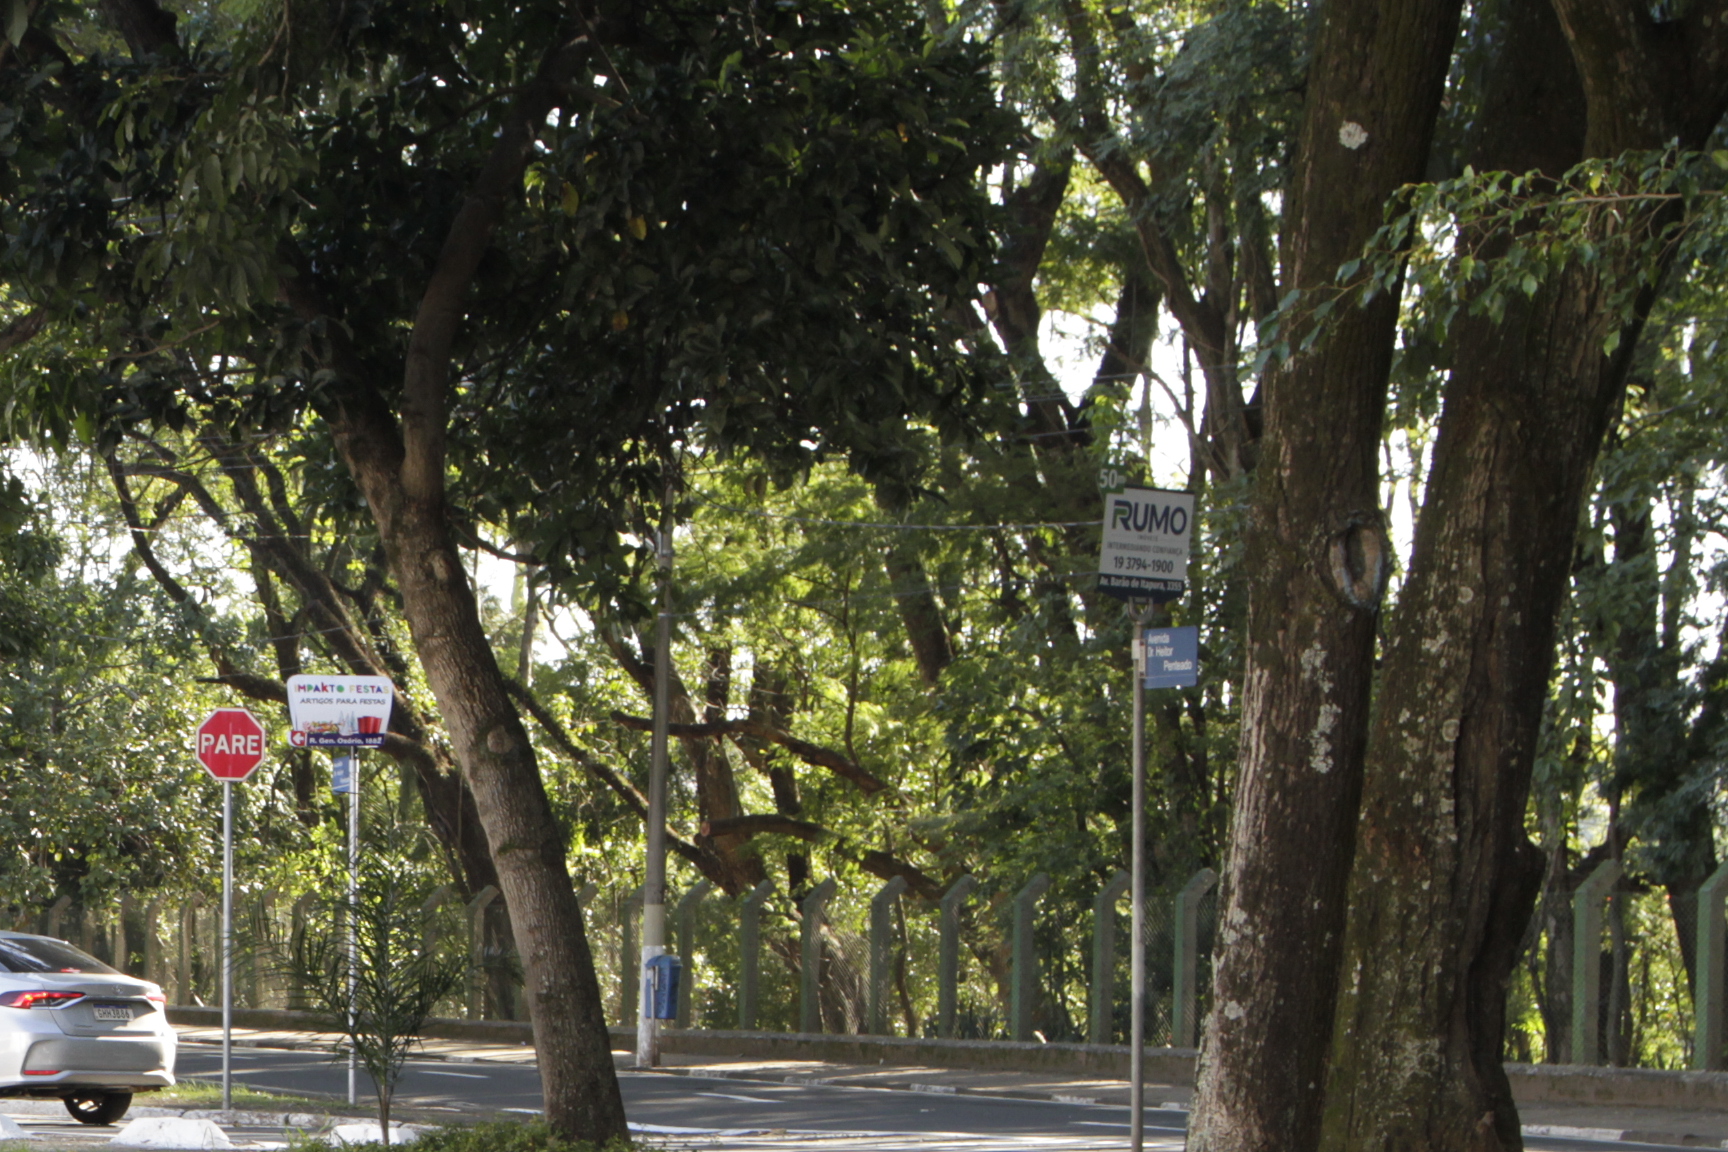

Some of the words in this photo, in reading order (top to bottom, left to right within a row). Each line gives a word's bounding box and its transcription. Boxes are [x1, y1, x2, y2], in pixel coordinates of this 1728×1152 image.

[1111, 500, 1187, 535] RUMO
[1114, 556, 1124, 569] 19
[1126, 557, 1174, 574] 3794-1900
[1130, 578, 1140, 588] de
[1148, 632, 1170, 644] Avenida
[1155, 645, 1174, 657] Heitor
[1163, 659, 1193, 671] Penteado
[349, 685, 390, 694] FESTAS
[200, 733, 260, 756] PARE
